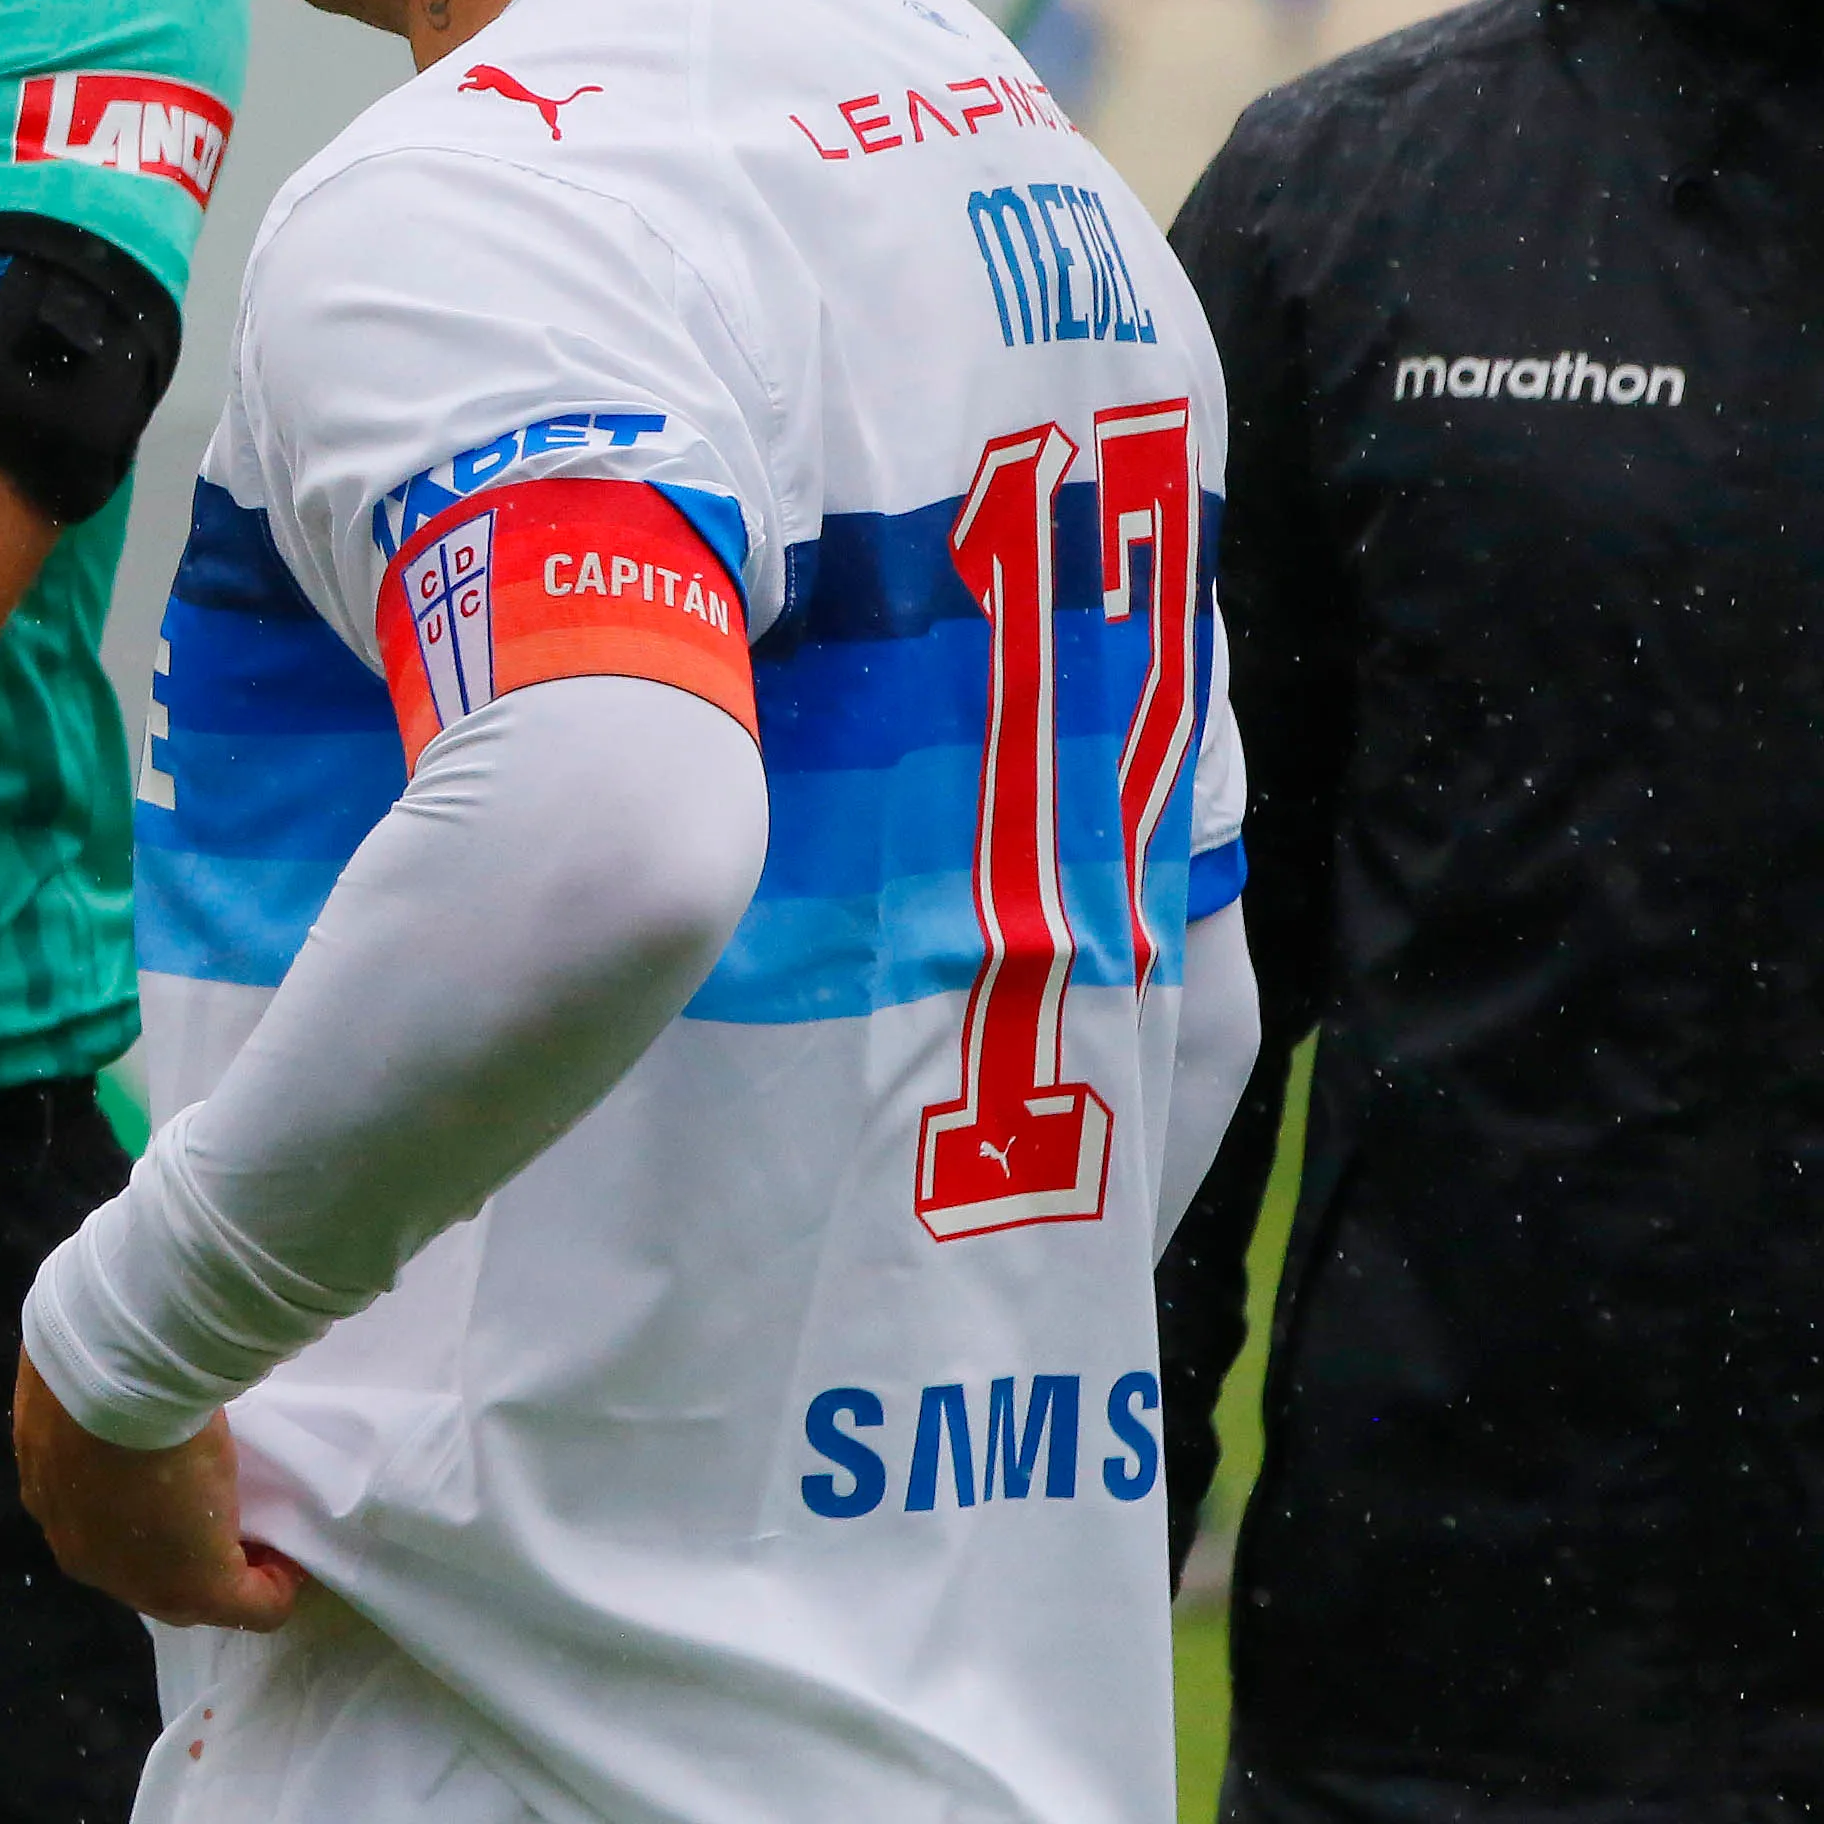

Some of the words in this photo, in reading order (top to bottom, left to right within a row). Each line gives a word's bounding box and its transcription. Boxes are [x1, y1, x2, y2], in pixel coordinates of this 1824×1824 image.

[42, 71, 230, 196] LANCO
[967, 183, 1158, 348] MEDEL
[1393, 350, 1687, 407] marathon
[543, 552, 730, 636] CAPITÁN
[914, 396, 1202, 1244] 17
[802, 1370, 1159, 1520] SAMS
